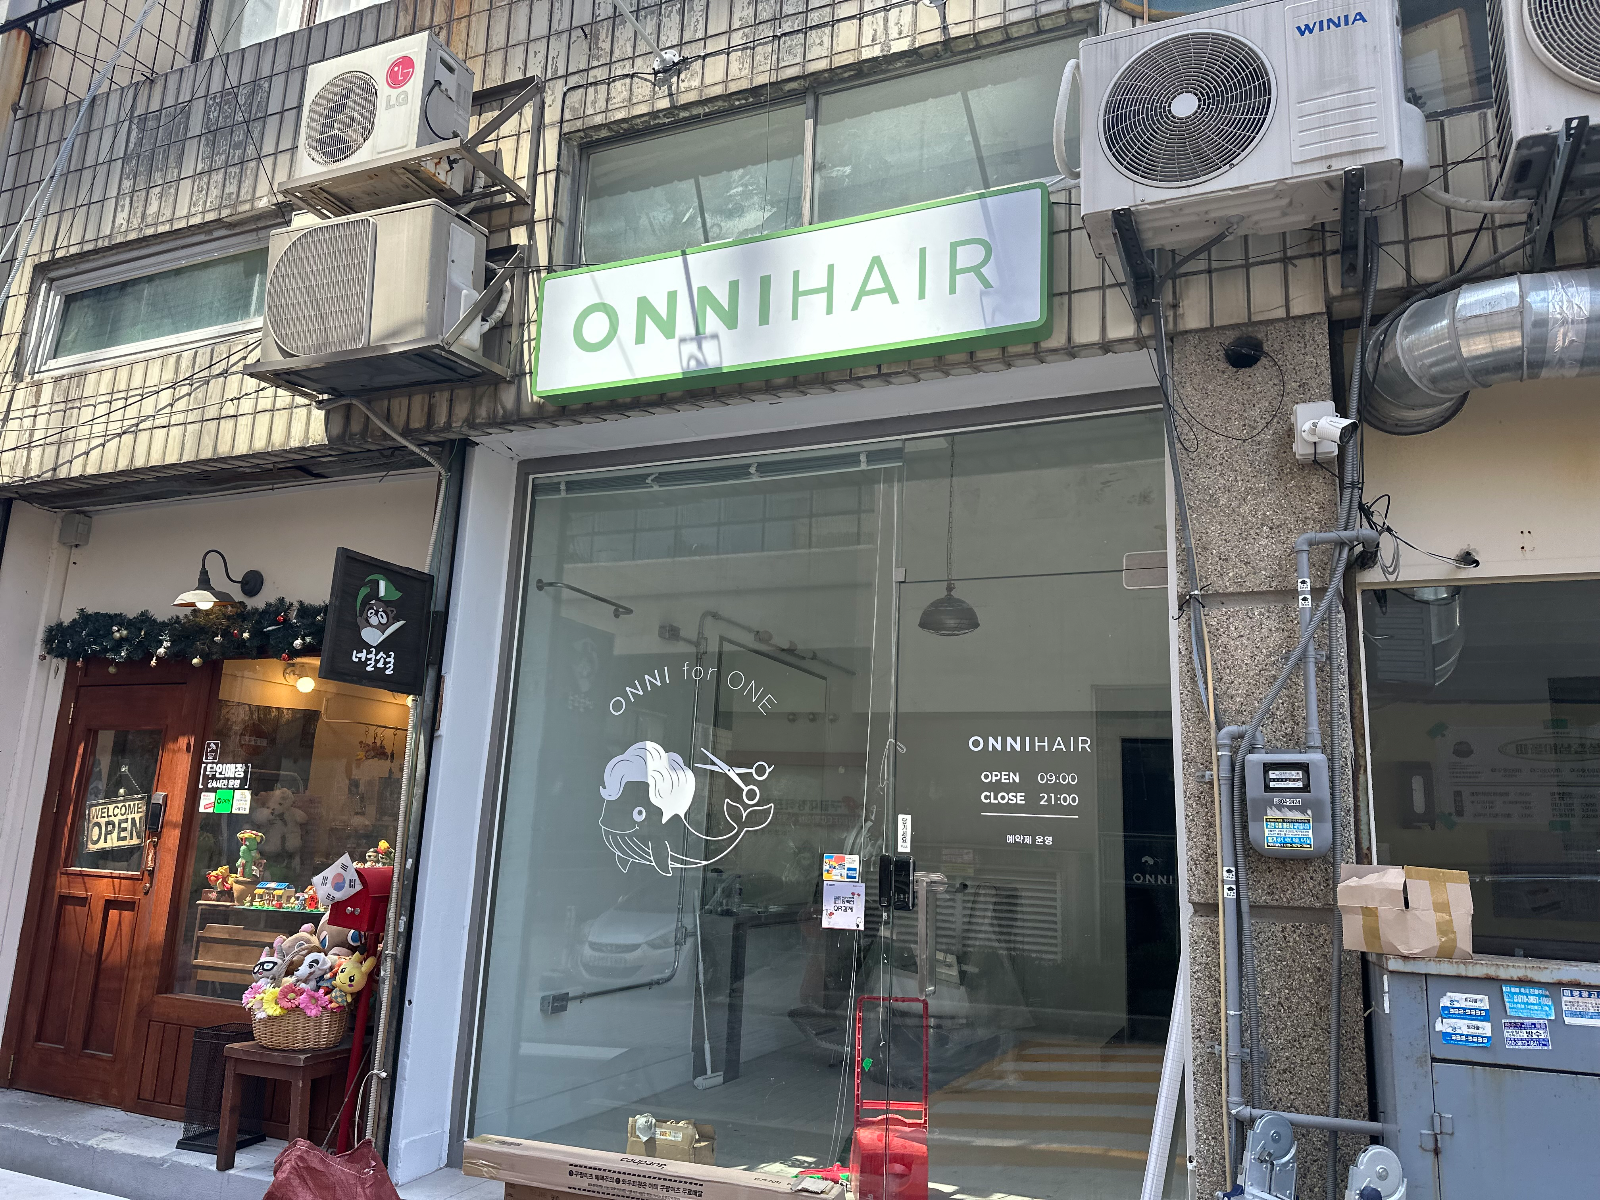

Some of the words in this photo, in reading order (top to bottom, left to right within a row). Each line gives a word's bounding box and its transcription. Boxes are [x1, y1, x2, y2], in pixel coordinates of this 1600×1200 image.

[1295, 11, 1368, 37] WINIA
[385, 90, 409, 110] LG
[572, 237, 994, 353] ONNIHAIR
[351, 648, 395, 675] 너굴소굴
[609, 666, 670, 716] ONNI
[682, 661, 718, 681] for
[727, 670, 778, 716] ONE
[968, 735, 1092, 753] ONNIHAIR
[205, 763, 246, 778] 무인매장
[980, 771, 1020, 783] OPEN
[1037, 772, 1078, 784] 09:00
[207, 779, 228, 788] 24시간
[980, 791, 1026, 804] CLOSE
[1039, 793, 1079, 806] 21:00
[91, 802, 143, 820] WELCOME
[90, 817, 145, 846] OPEN
[1006, 834, 1032, 845] 예약제
[1035, 835, 1053, 846] 운영
